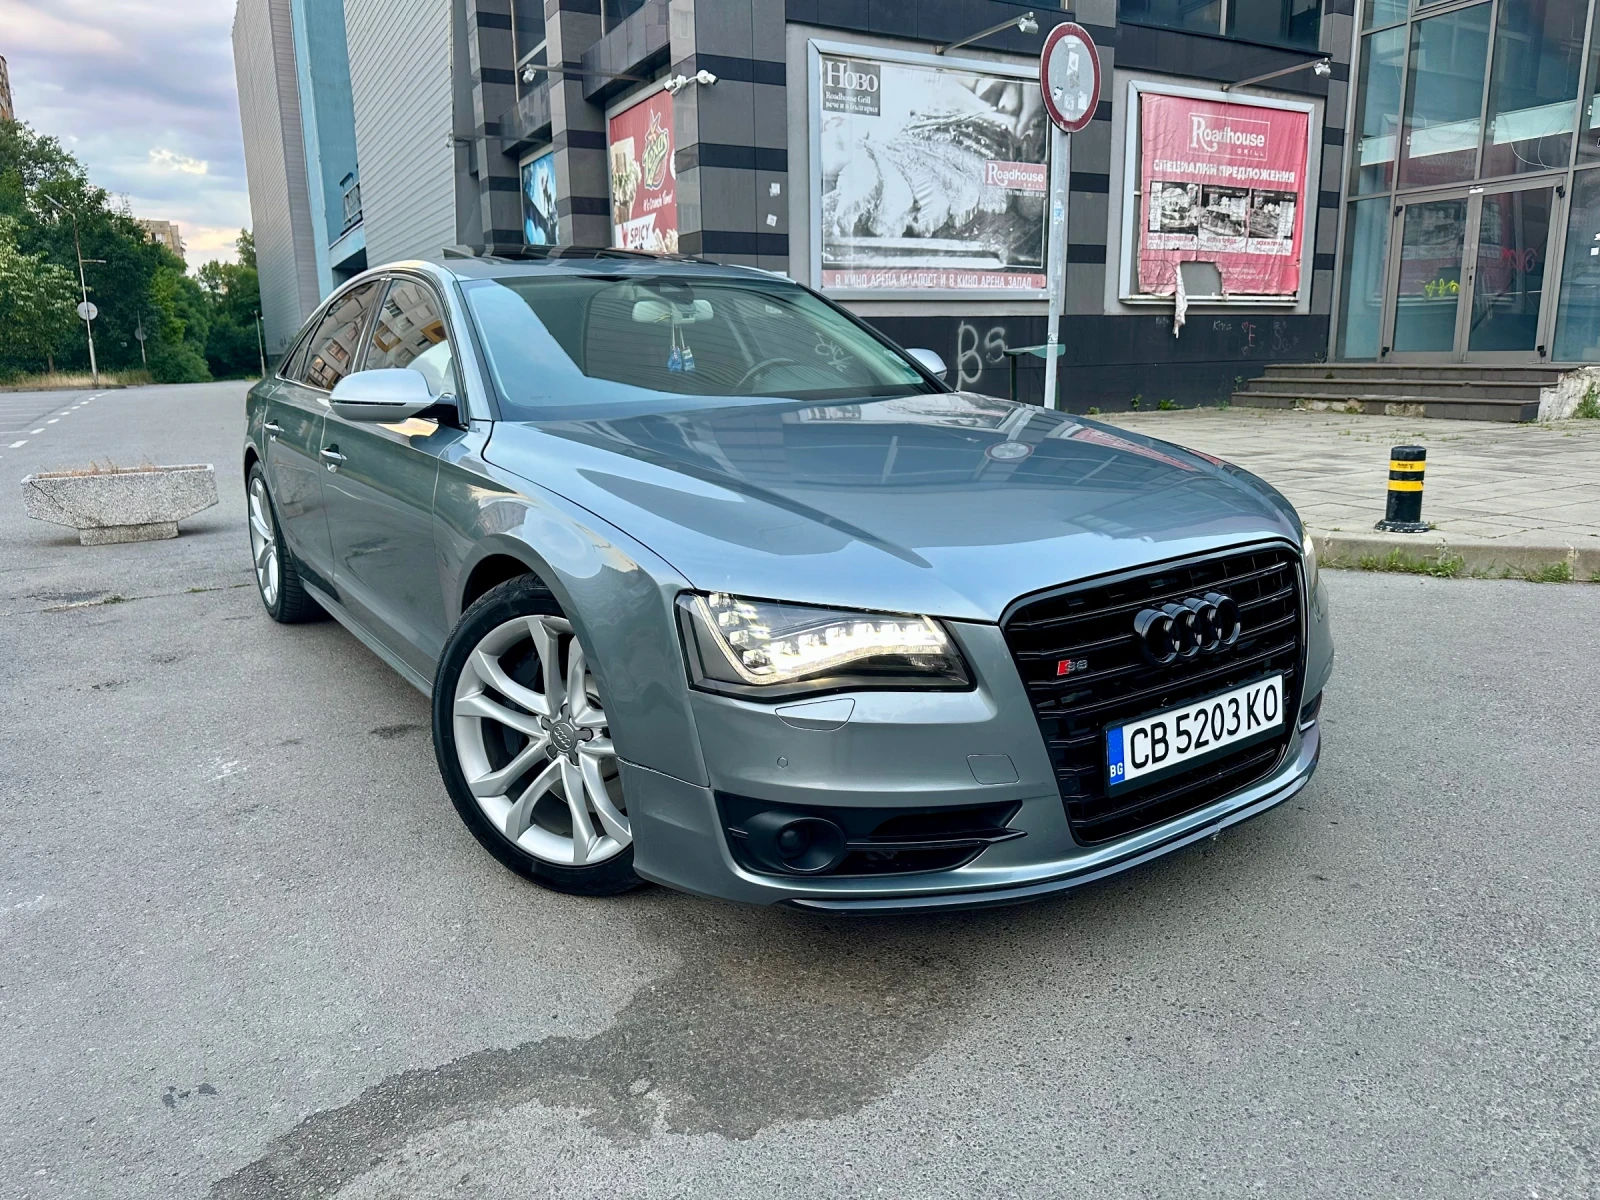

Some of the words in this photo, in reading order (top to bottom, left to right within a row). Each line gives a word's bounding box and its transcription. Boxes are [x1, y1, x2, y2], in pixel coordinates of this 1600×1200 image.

[858, 95, 871, 104] Grill
[1190, 116, 1265, 152] Roadhouse
[1237, 147, 1264, 156] GRILL
[986, 162, 1044, 187] Roadhouse
[1153, 159, 1217, 176] СПЕЦИАЛНИ
[1219, 164, 1295, 184] ПРЕДЛОЖЕНИЯ
[630, 223, 650, 244] SPICY
[835, 273, 841, 288] В
[844, 273, 867, 288] КИНО
[870, 273, 896, 288] АРЕНА
[899, 273, 937, 288] МЛАДОСТ
[940, 274, 946, 286] И
[948, 274, 954, 287] В
[957, 274, 977, 288] КИНО
[980, 275, 1005, 288] АРЕНА
[1008, 276, 1032, 289] ЗАПАД
[1062, 659, 1088, 673] S8
[1130, 720, 1170, 769] CB
[1176, 697, 1241, 754] 5203
[1246, 684, 1279, 731] KO
[1110, 763, 1124, 777] BG
